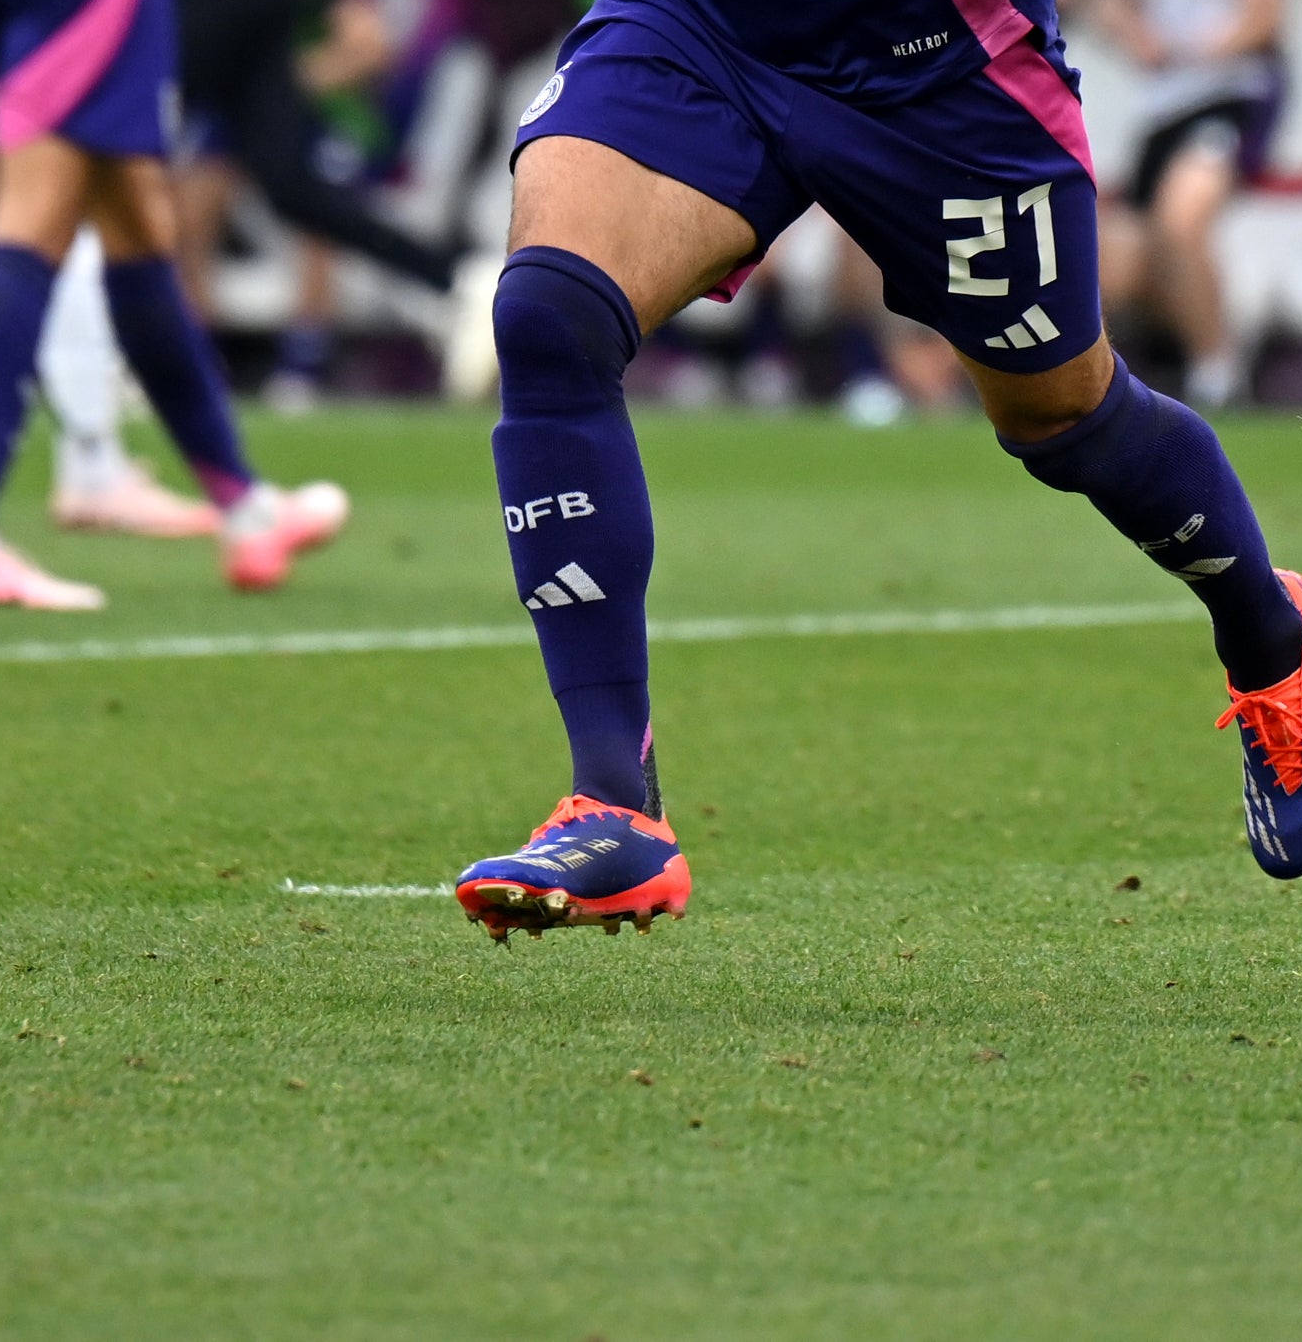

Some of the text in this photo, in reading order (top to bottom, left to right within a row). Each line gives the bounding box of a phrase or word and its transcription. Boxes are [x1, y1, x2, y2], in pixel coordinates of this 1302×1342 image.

[891, 30, 948, 57] HEAT.RDY
[942, 181, 1057, 297] 21
[504, 491, 597, 533] DFB
